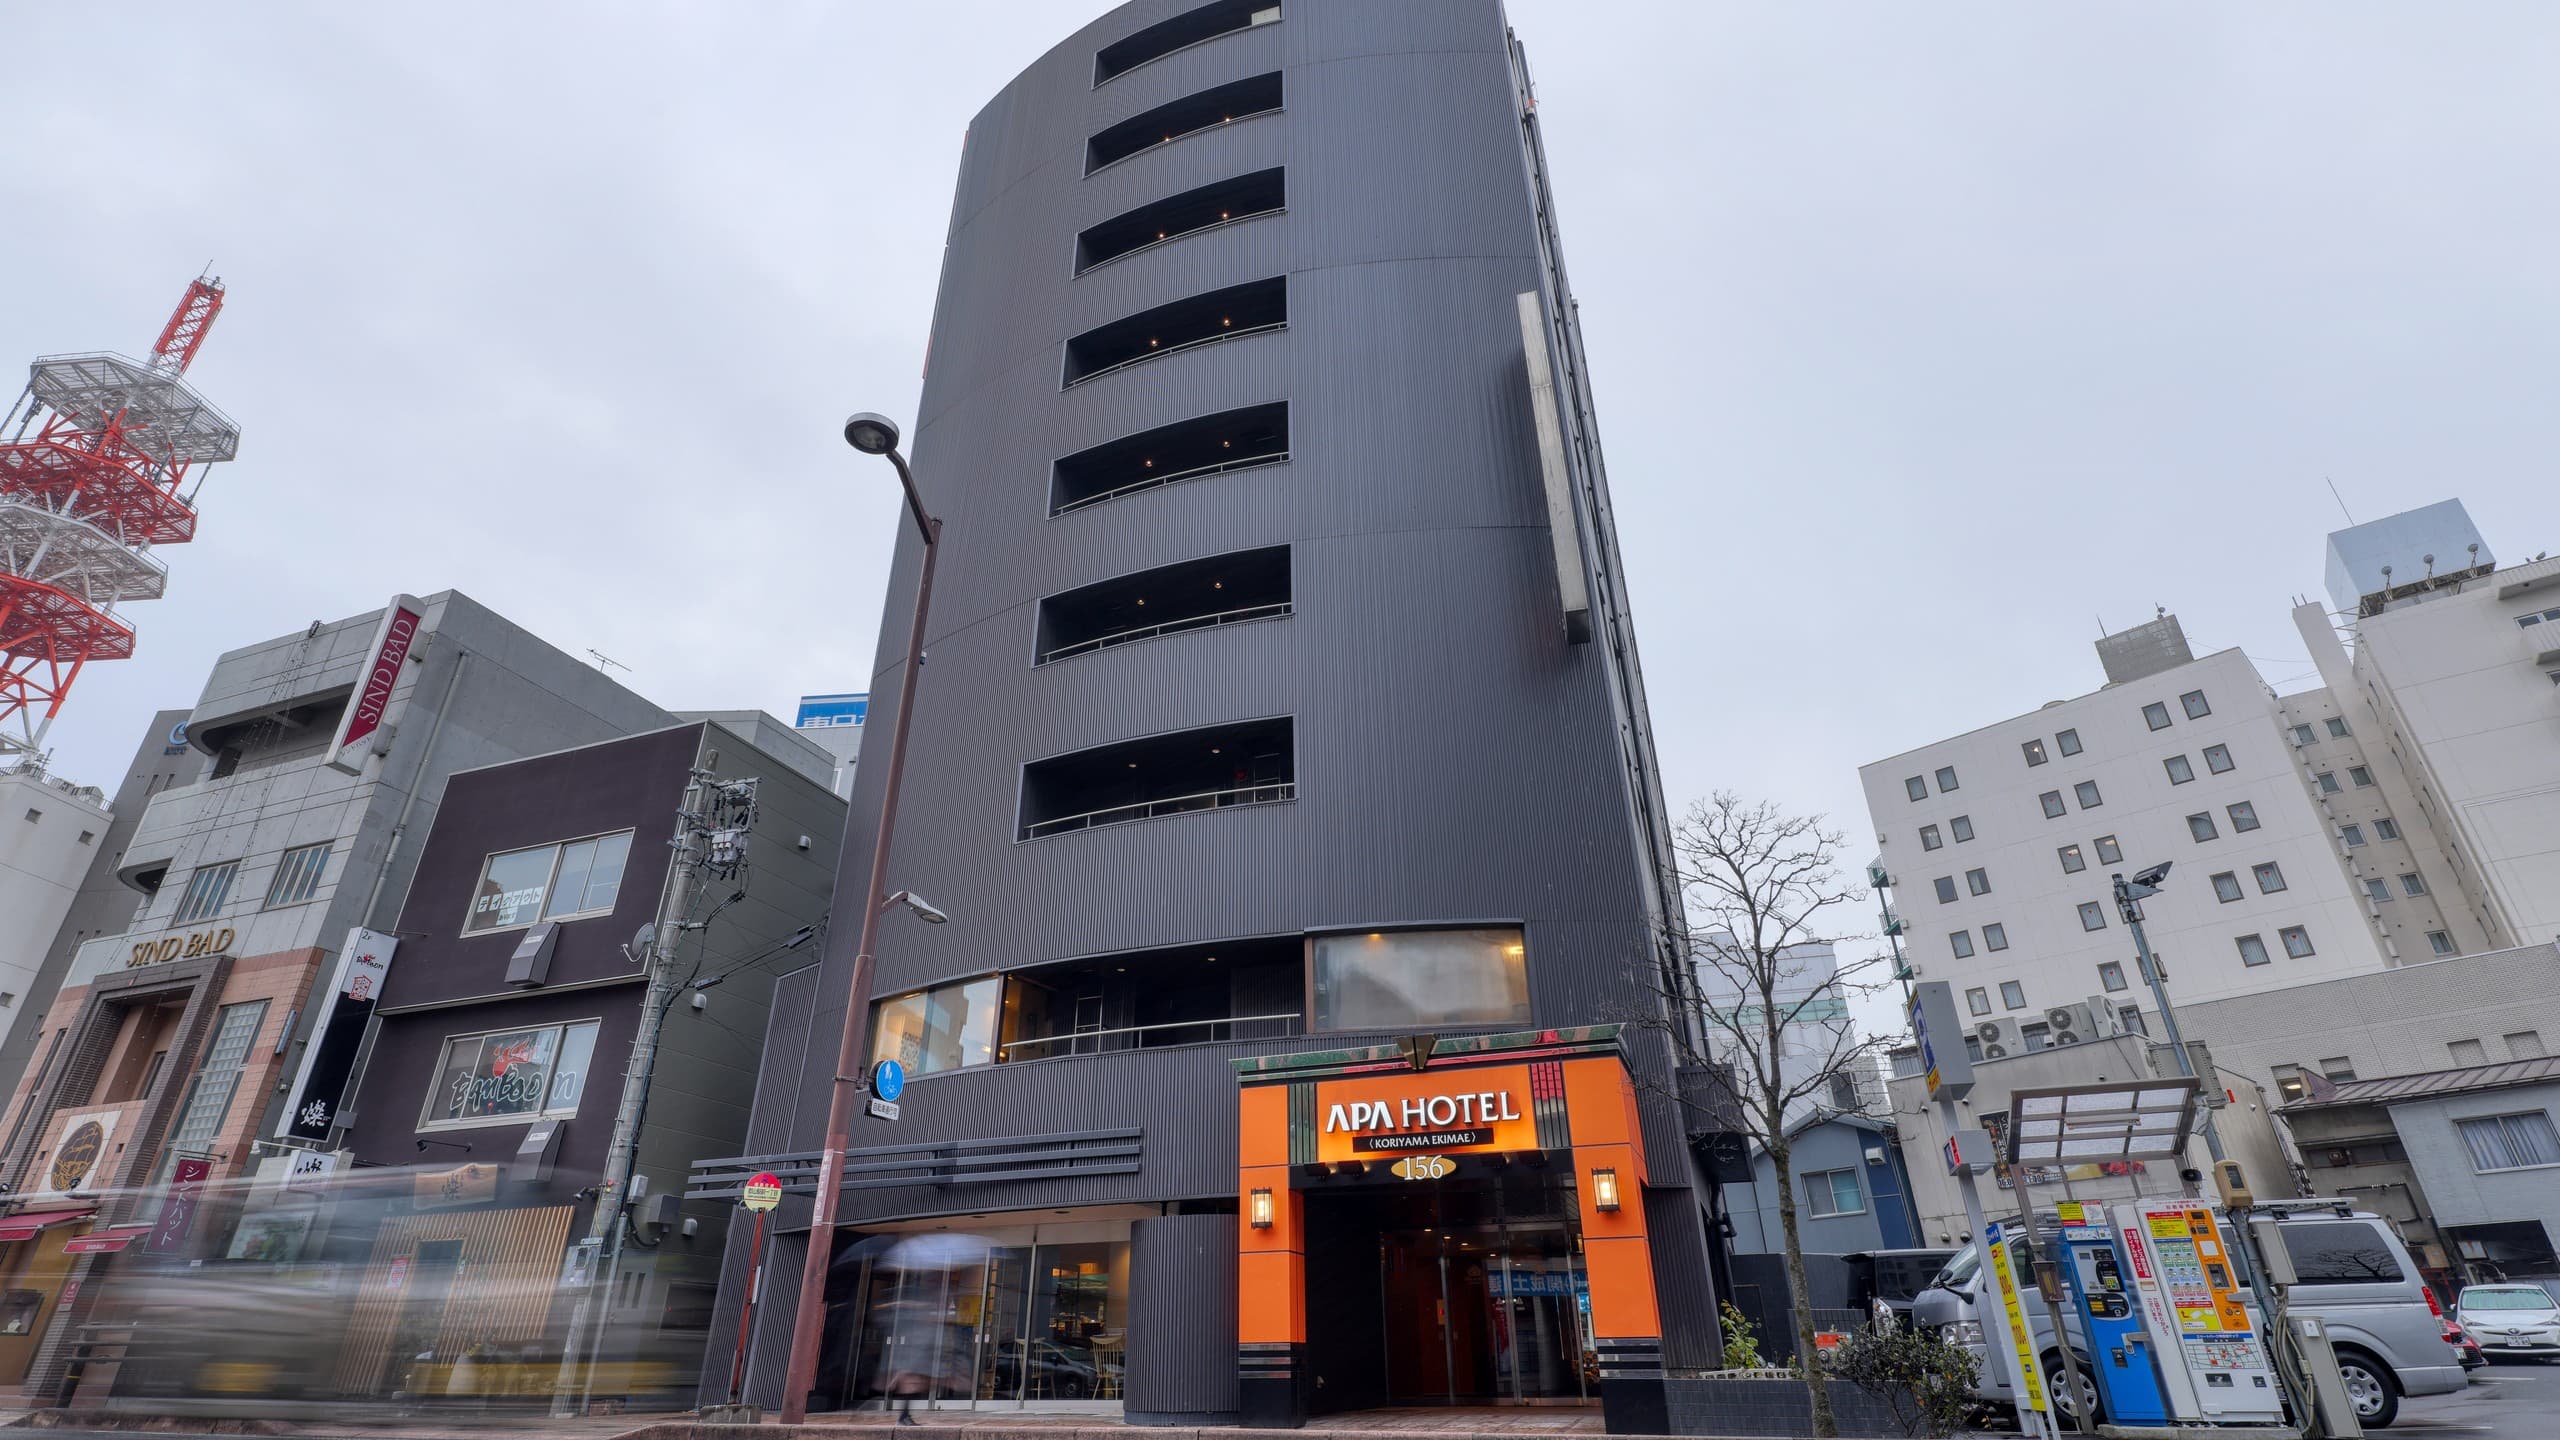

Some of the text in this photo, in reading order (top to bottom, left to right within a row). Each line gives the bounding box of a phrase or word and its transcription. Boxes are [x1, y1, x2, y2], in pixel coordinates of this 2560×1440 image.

[358, 619, 412, 724] SIND BAD
[126, 928, 235, 968] SIND BAD
[1326, 1091, 1521, 1133] APA HOTEL
[1403, 1154, 1445, 1181] 156
